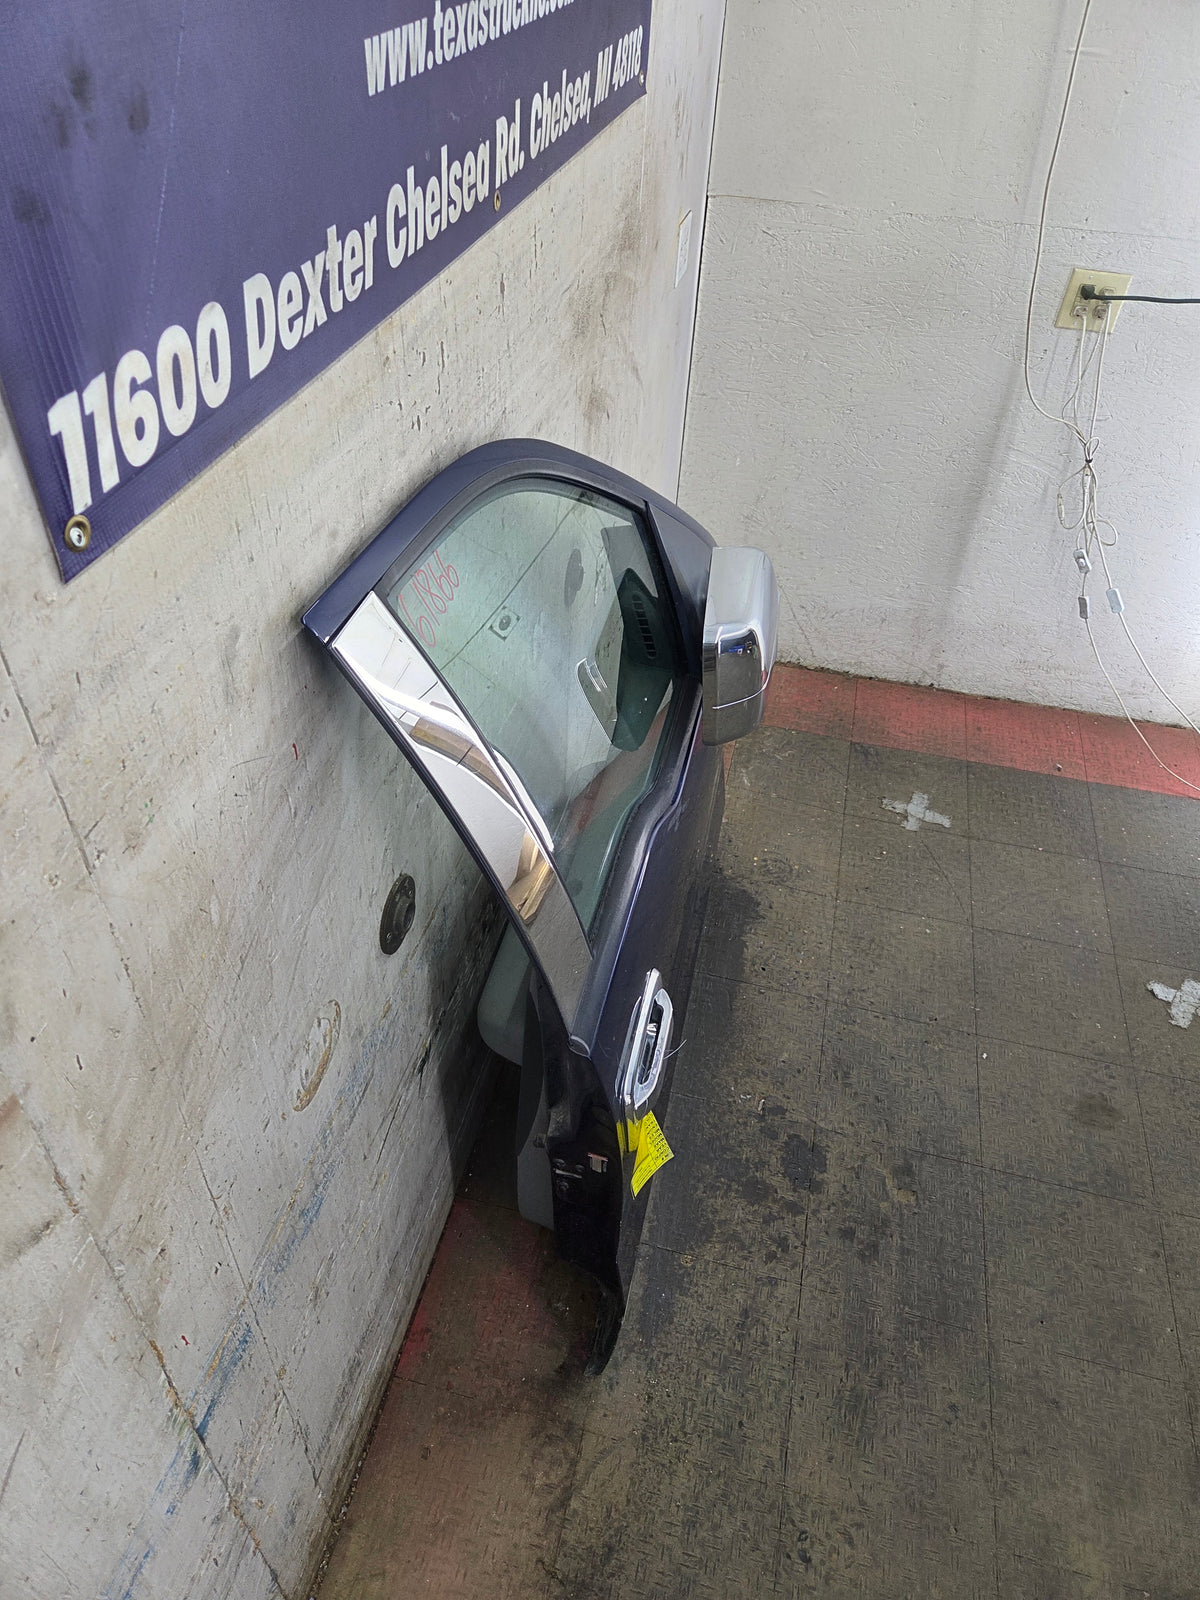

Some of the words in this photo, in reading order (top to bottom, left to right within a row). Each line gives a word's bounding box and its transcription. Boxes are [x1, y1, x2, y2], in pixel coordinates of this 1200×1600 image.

[47, 301, 231, 515] 11600
[242, 215, 377, 379] Dexter
[386, 139, 490, 269] Chelsea
[495, 98, 525, 190] Rd.
[529, 68, 591, 160] Chelsea,
[593, 43, 613, 108] MI
[612, 24, 644, 92] 48118
[398, 549, 460, 649] 61866
